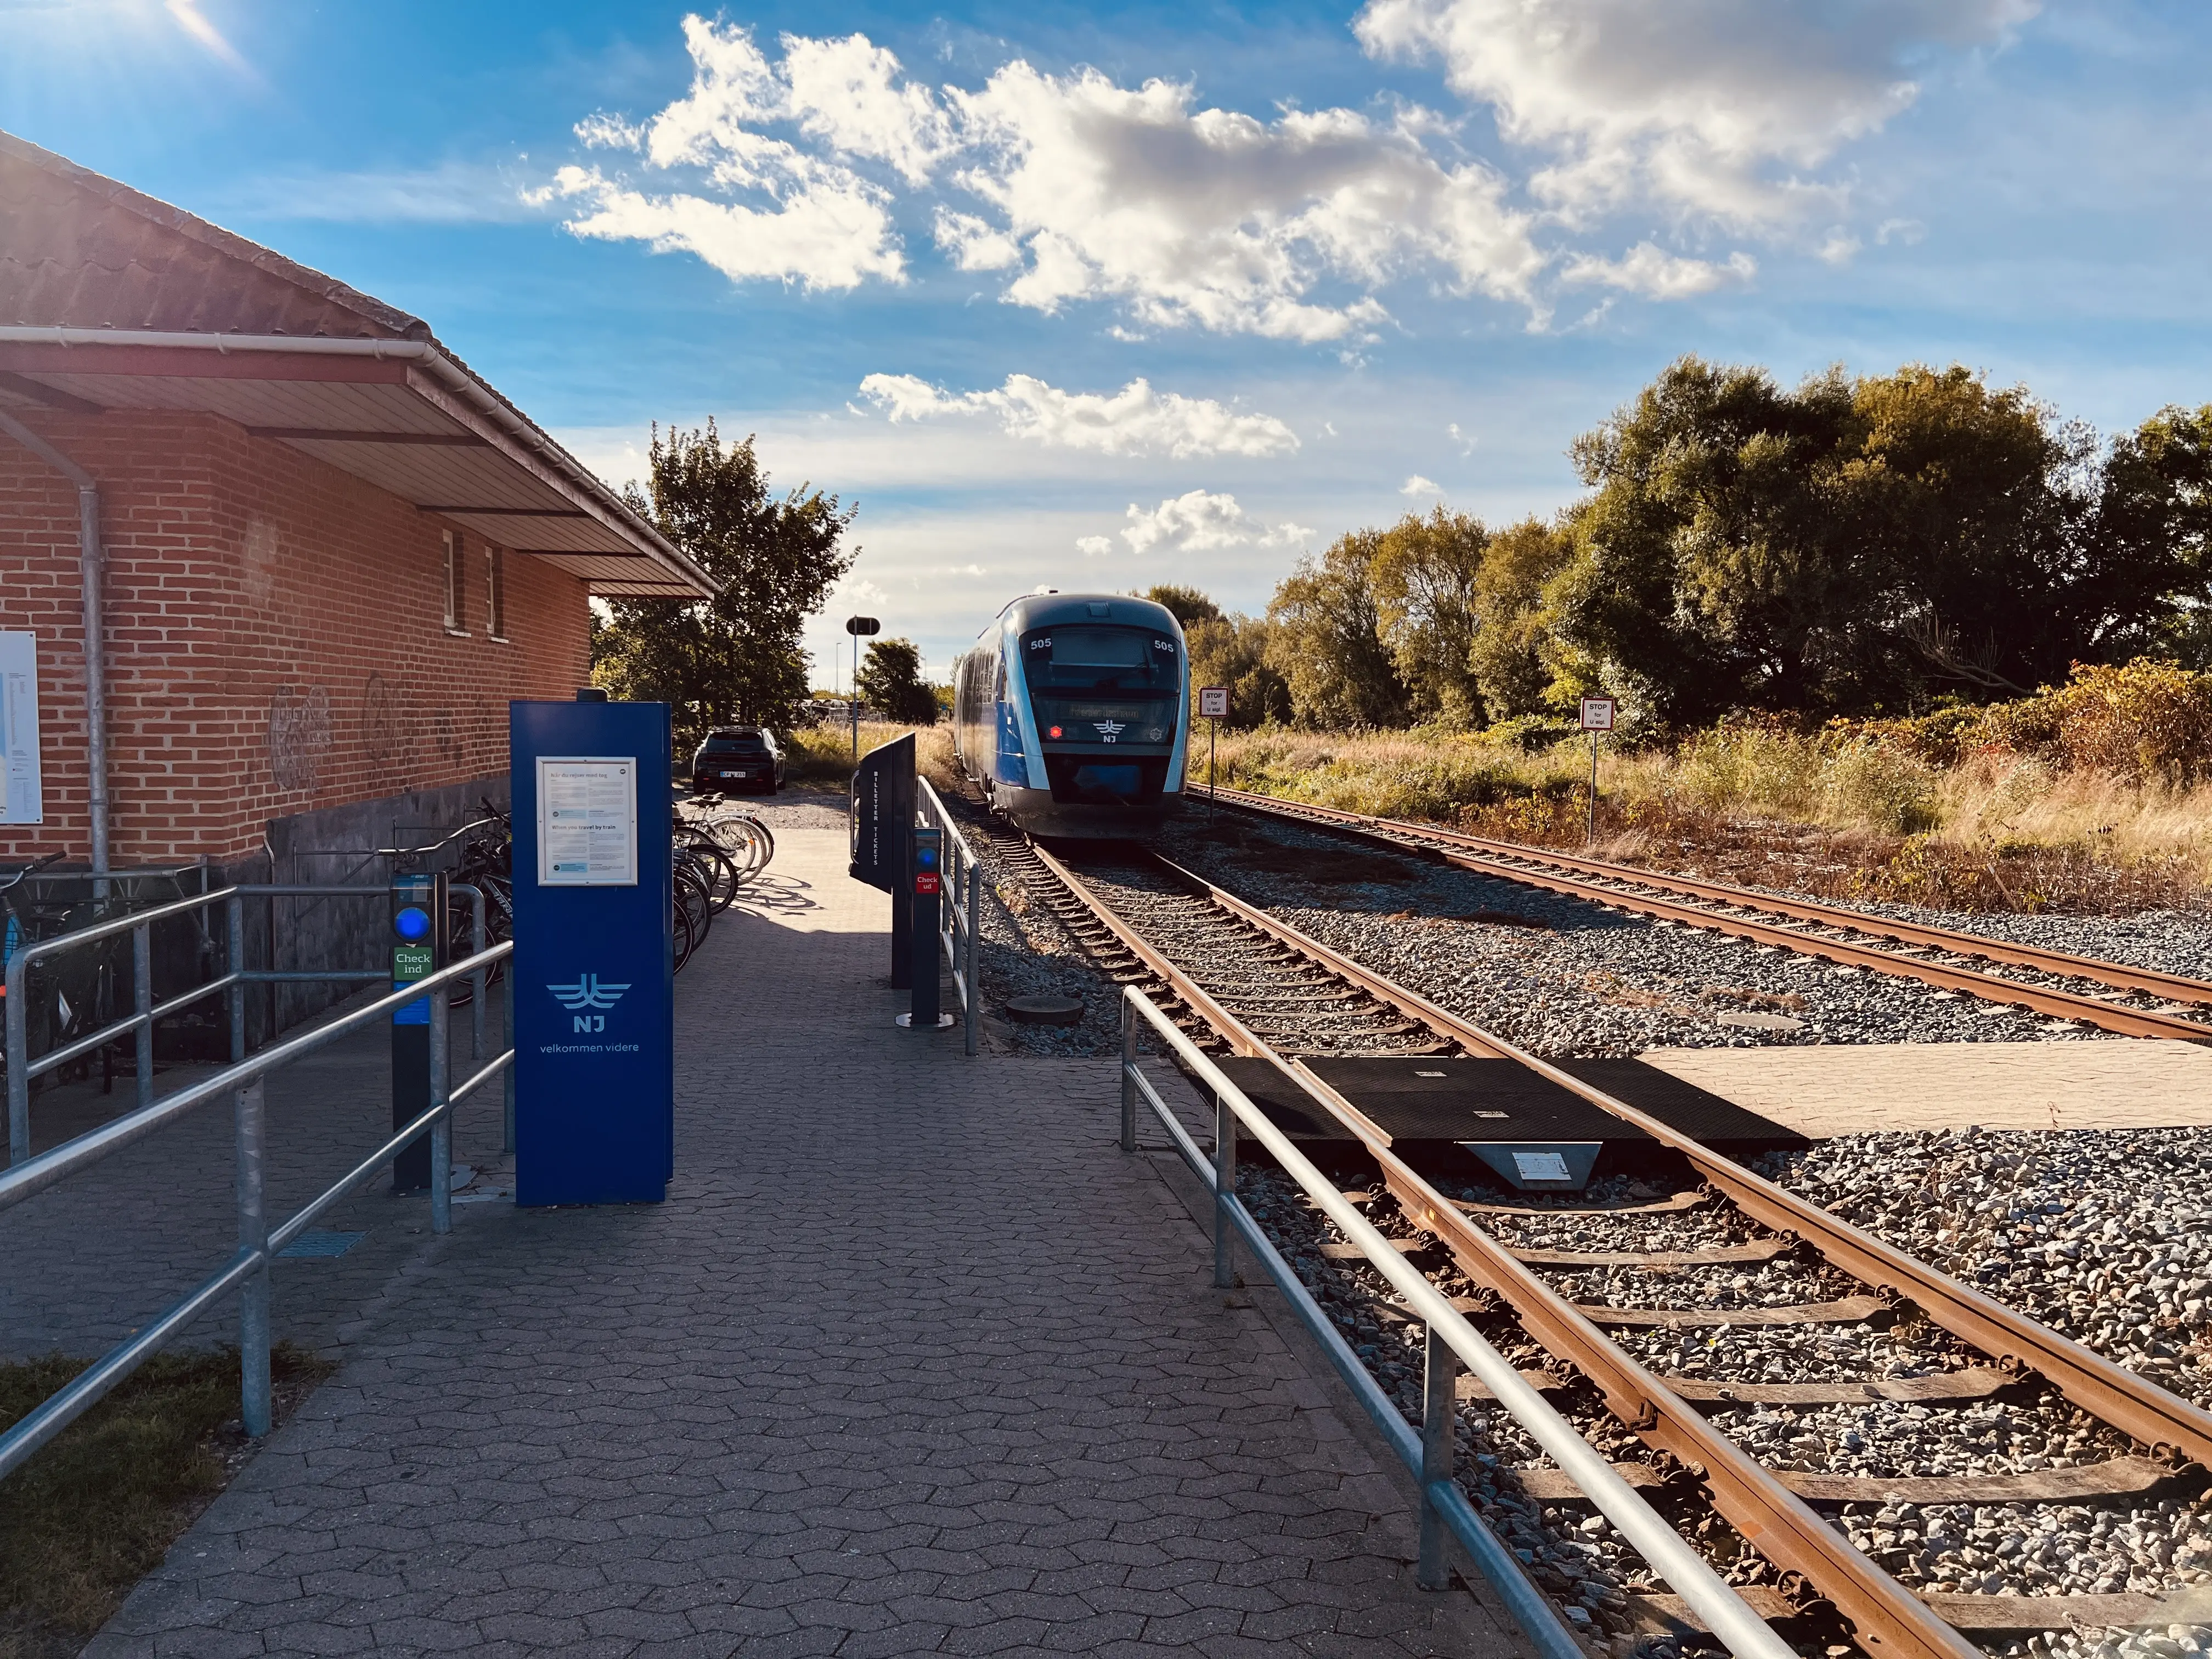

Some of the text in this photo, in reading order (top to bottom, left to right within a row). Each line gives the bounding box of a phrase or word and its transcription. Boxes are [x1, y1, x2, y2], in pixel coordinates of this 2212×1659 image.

[1031, 637, 1052, 650] 505
[1154, 640, 1174, 652] 505
[396, 953, 431, 963] Check
[404, 964, 422, 973] ind
[574, 1015, 605, 1033] NJ
[540, 1042, 639, 1053] velkommen videre
